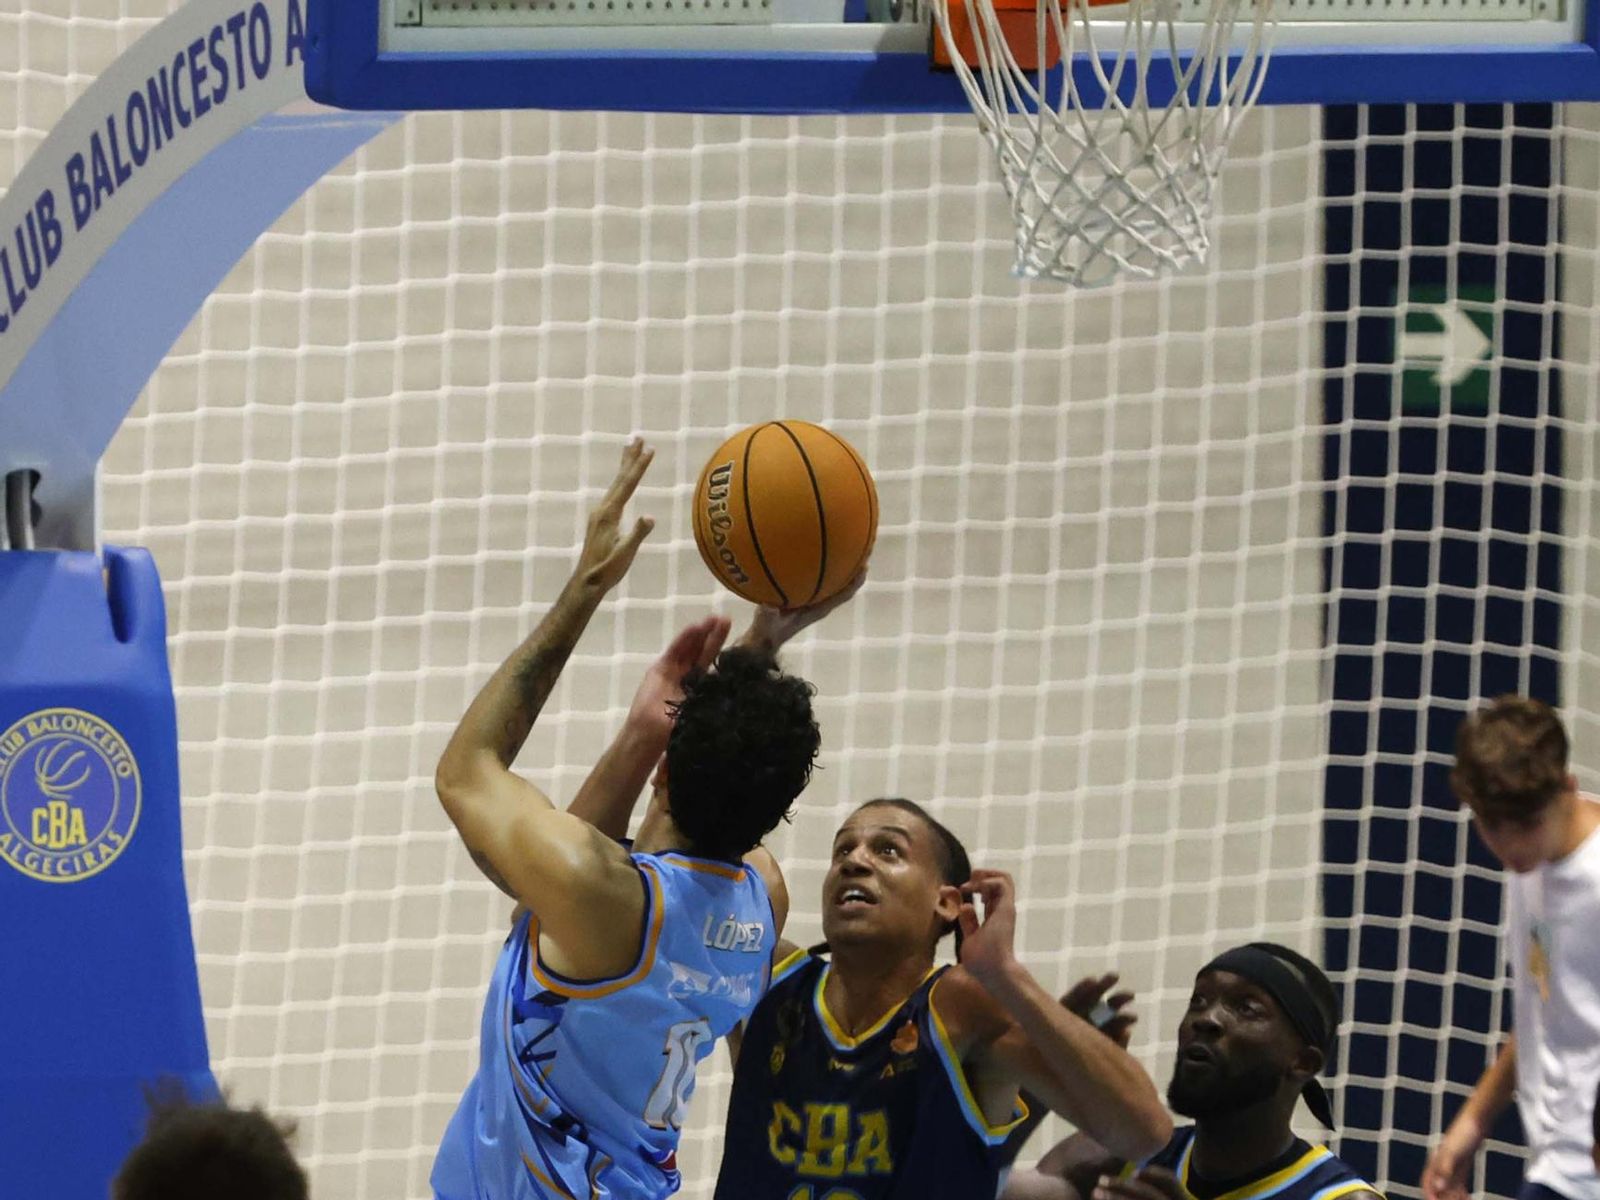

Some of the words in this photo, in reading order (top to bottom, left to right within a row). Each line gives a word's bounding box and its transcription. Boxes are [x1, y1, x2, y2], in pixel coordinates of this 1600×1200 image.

[65, 2, 272, 232] BALONCESTO
[26, 714, 133, 779] BALONCESTO
[0, 830, 124, 876] ALGECIRAS
[32, 800, 88, 849] CBA
[768, 1101, 894, 1177] CBA
